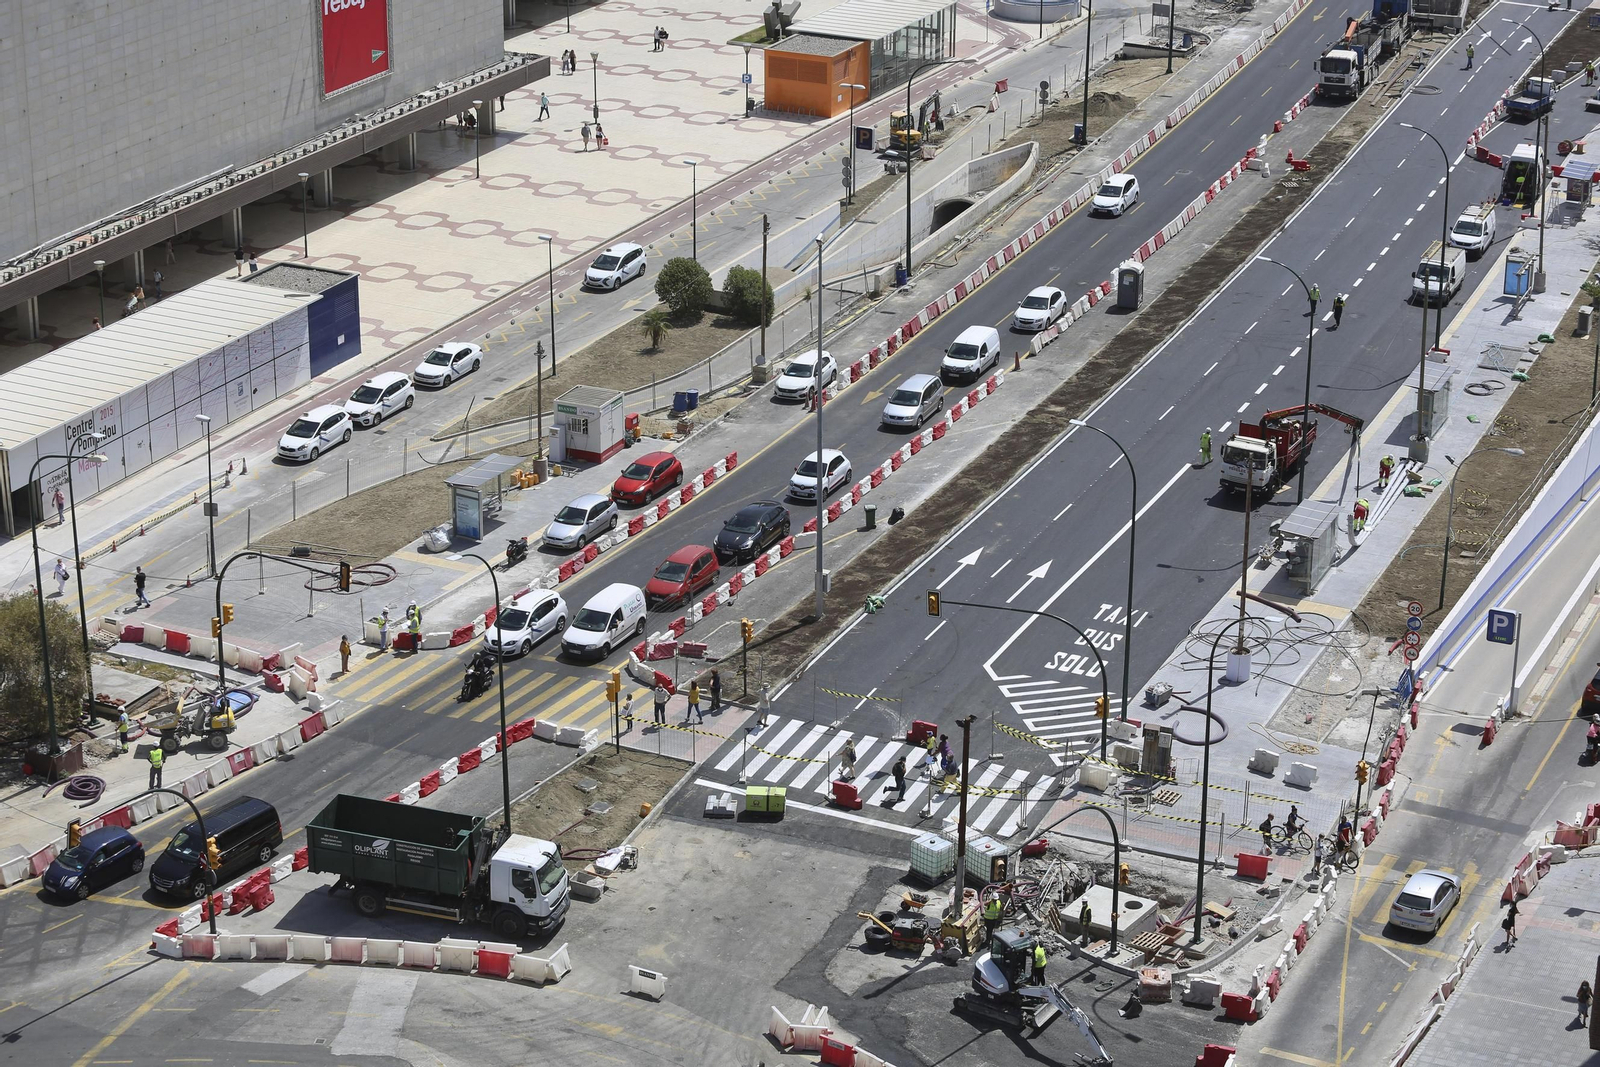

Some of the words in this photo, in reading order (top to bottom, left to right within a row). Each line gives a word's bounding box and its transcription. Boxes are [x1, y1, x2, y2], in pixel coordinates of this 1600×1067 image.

[860, 130, 869, 143] P
[99, 405, 114, 421] 2015
[67, 419, 93, 440] Centre
[1093, 603, 1149, 628] TAXI
[1492, 613, 1509, 634] P
[1074, 627, 1124, 652] BUS
[1044, 651, 1109, 678] SOLO
[354, 844, 389, 856] OLIPLANT
